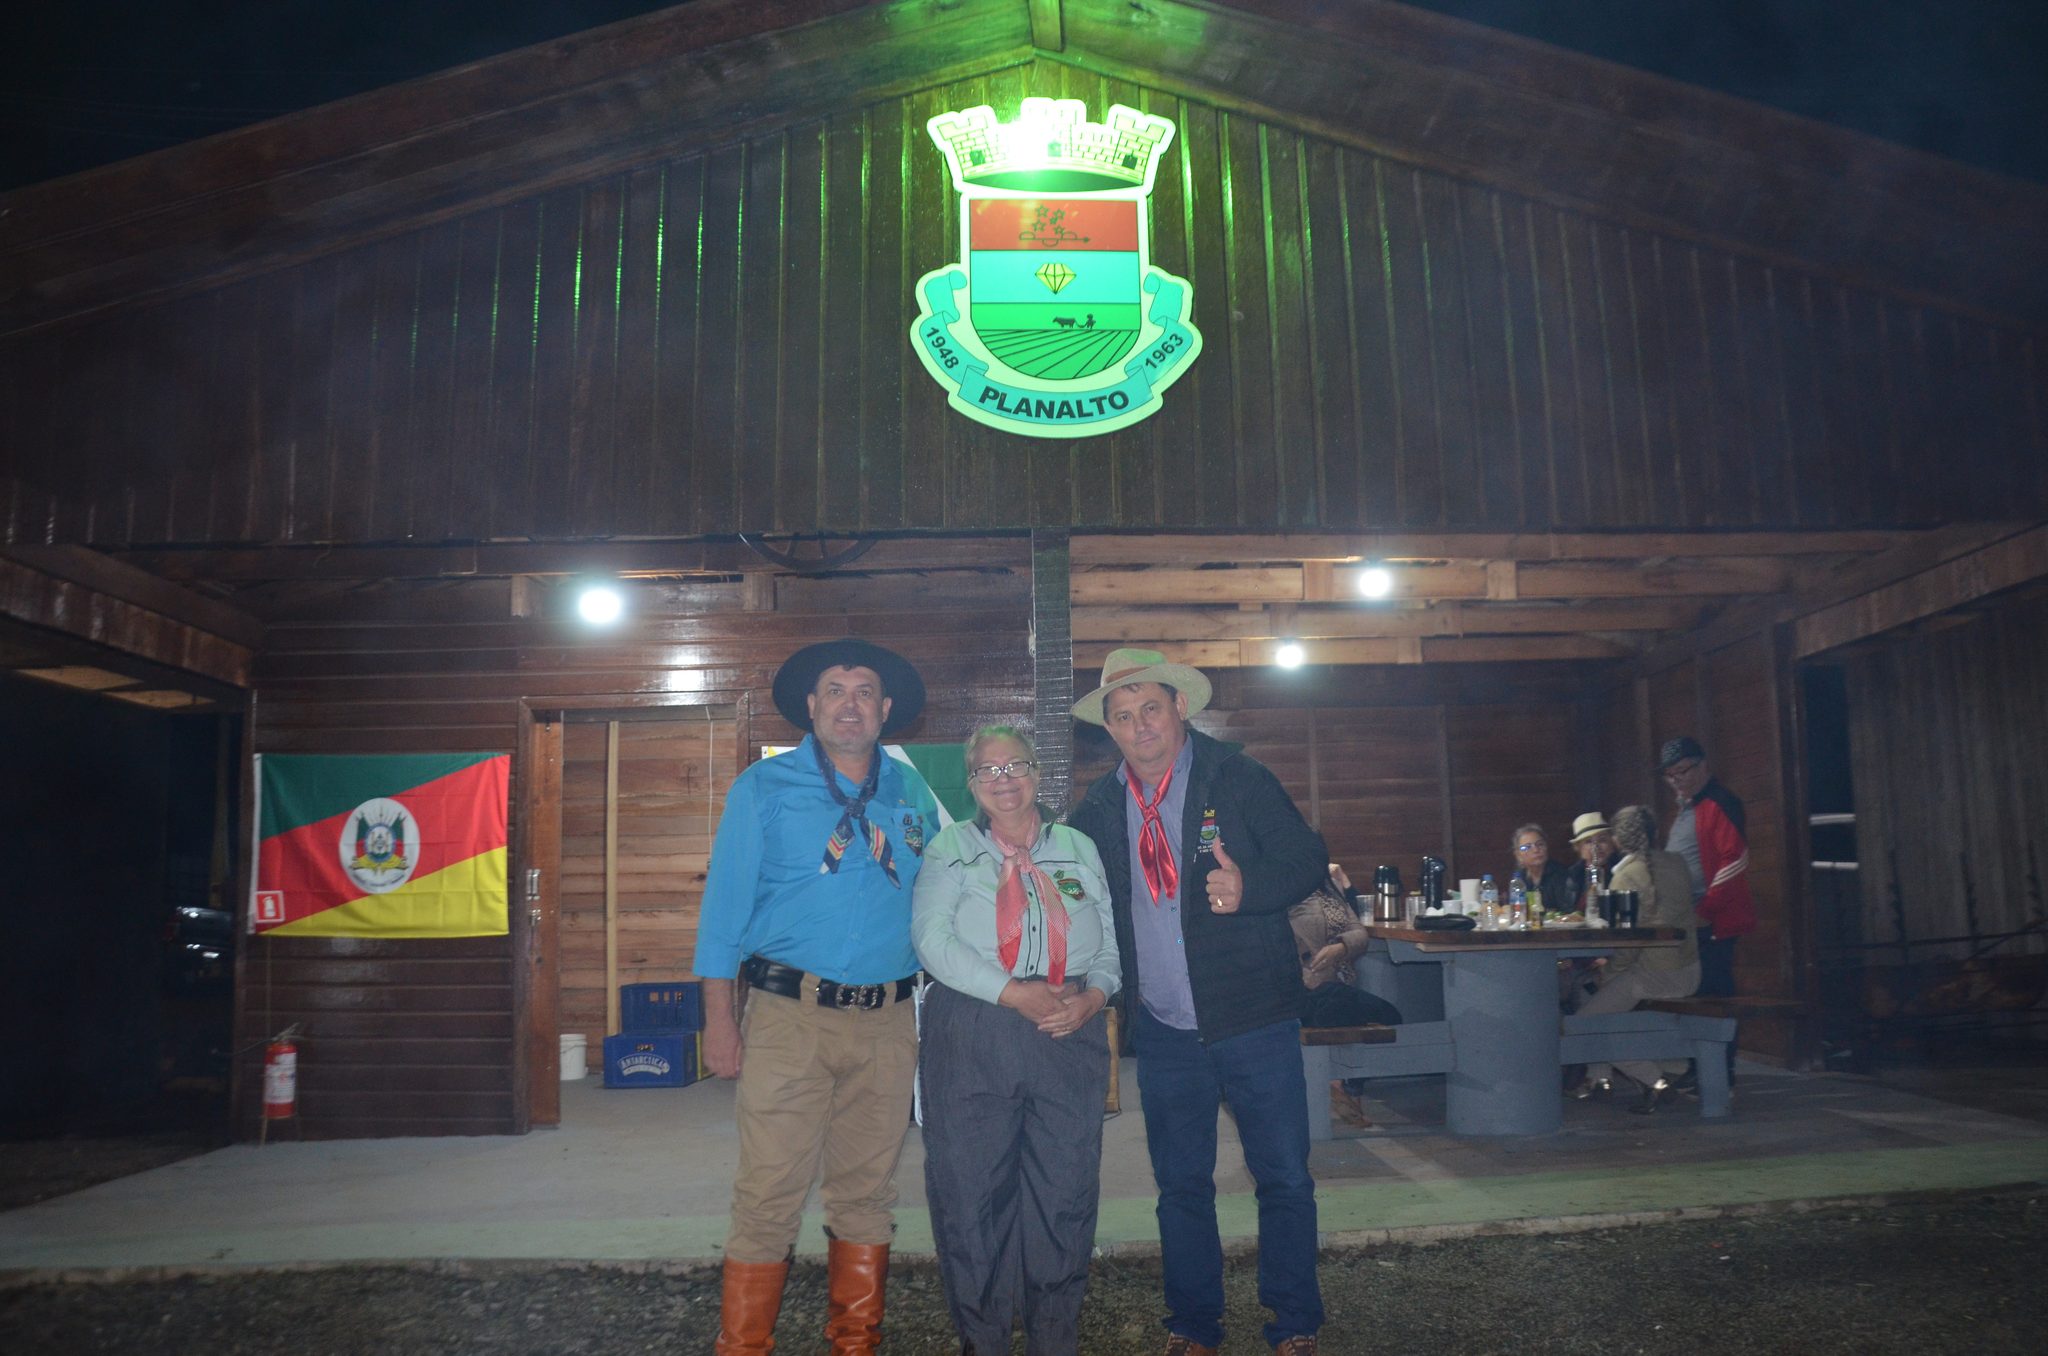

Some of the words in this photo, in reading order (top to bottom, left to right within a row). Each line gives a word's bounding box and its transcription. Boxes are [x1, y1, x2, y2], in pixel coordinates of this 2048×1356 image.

[926, 327, 959, 369] 1948
[1145, 333, 1183, 368] 1963
[978, 385, 1130, 419] PLANALTO
